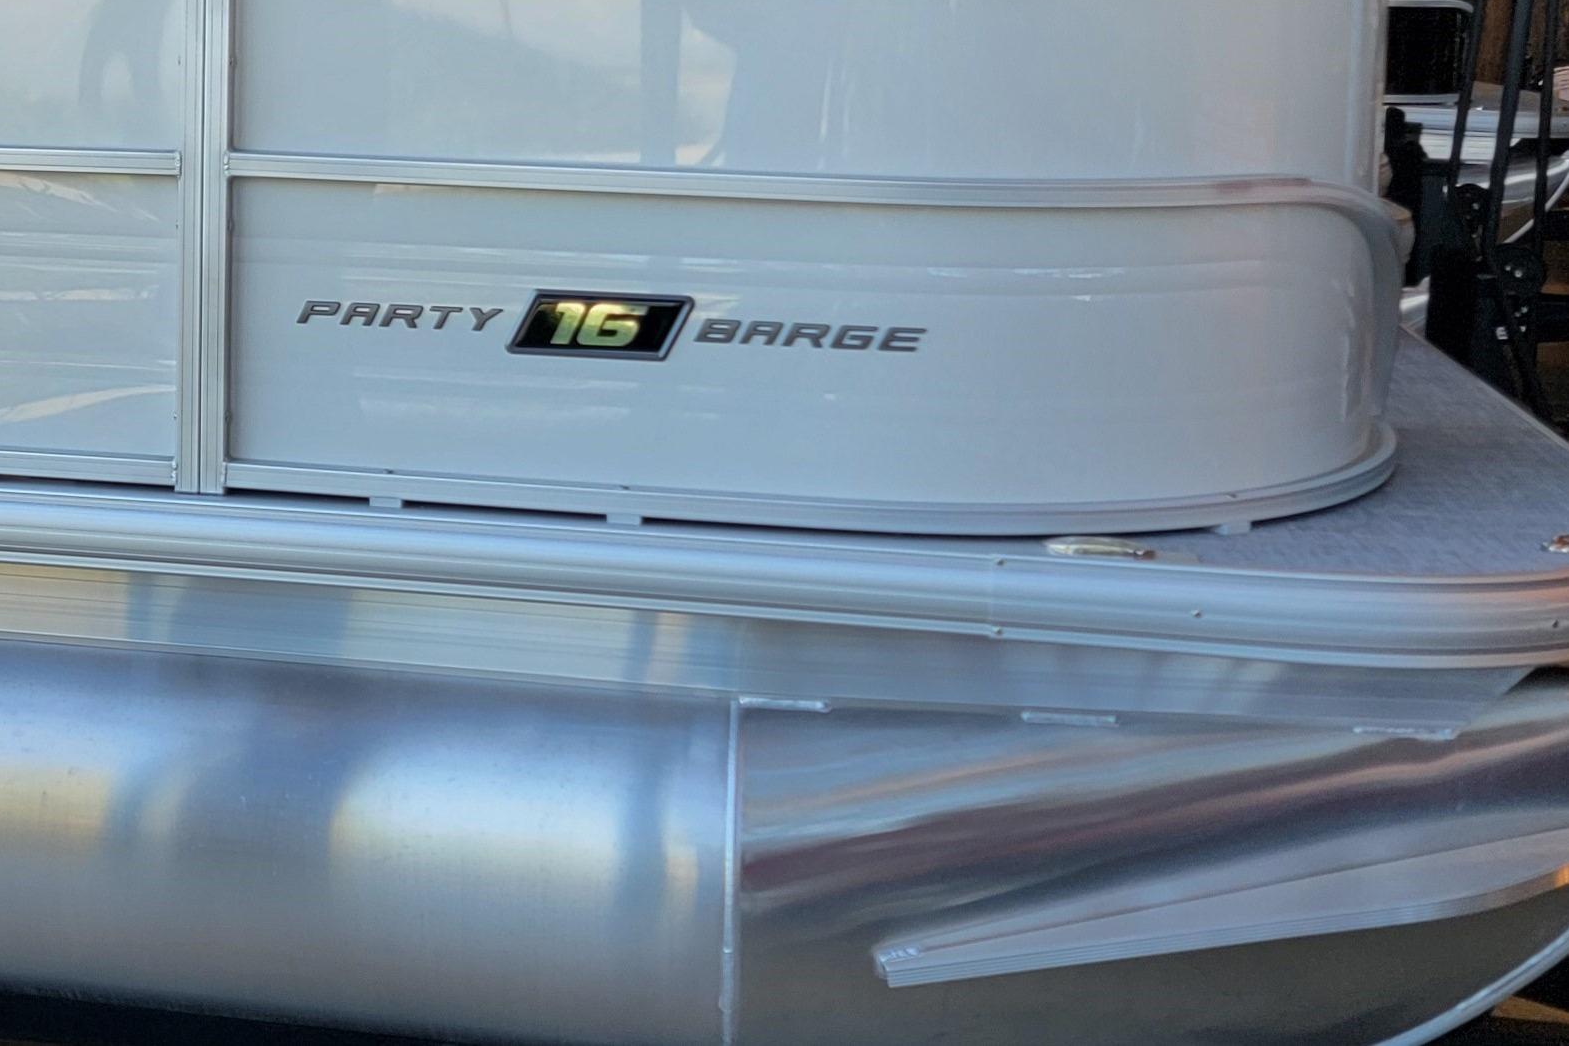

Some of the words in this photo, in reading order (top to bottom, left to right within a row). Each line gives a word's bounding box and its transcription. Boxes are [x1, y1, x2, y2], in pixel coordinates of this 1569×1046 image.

[296, 300, 503, 331] PARTY
[548, 301, 649, 347] 16
[693, 318, 928, 353] BARGE
